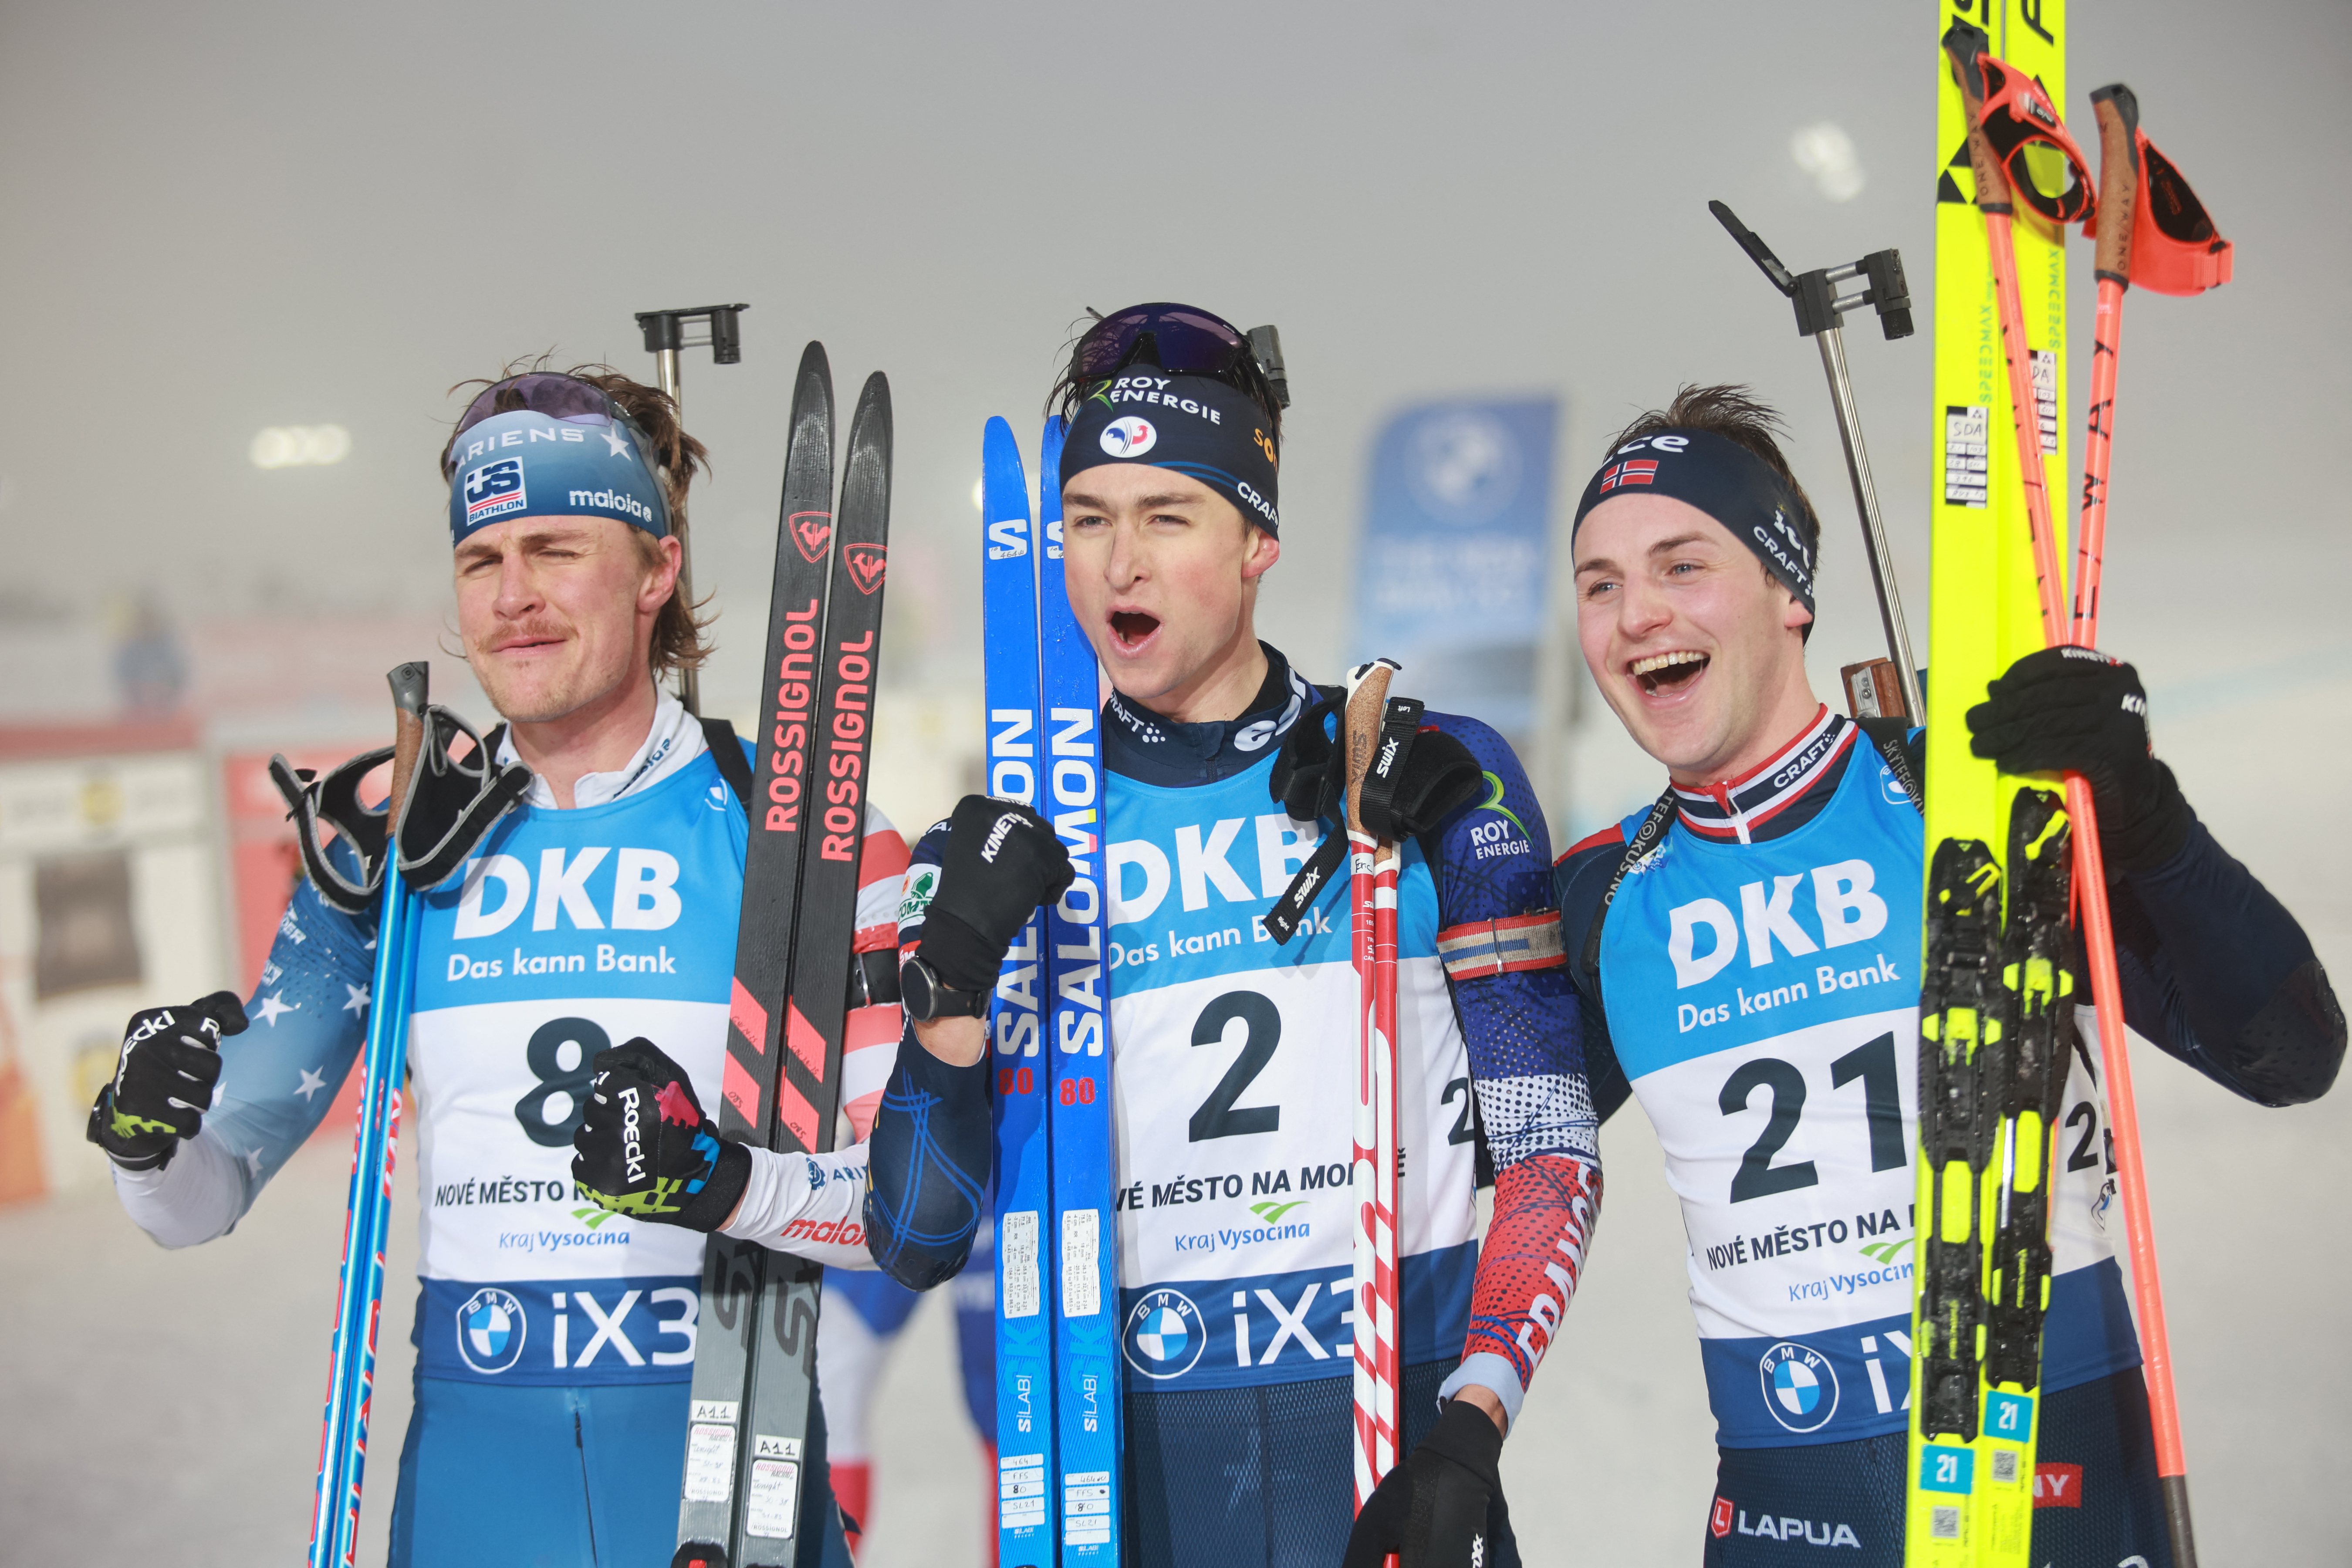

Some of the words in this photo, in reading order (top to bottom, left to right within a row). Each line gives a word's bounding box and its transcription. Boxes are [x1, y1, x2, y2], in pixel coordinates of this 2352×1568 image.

[1979, 305, 1993, 403] SPEEDMAX
[1114, 376, 1171, 390] ROY
[1110, 389, 1220, 425] ENERGIE
[456, 428, 585, 473] ARIENS
[469, 499, 524, 524] BIATHLON
[569, 489, 642, 518] maloja
[1753, 525, 1808, 584] CRAFT
[765, 599, 818, 831] ROSSIGNOL
[821, 630, 874, 862] ROSSIGNOL
[1773, 740, 1827, 789] CRAFT
[1470, 819, 1509, 846] ROY
[1476, 839, 1530, 860] ENERGIE
[1050, 707, 1103, 1058] SALOMON
[1106, 812, 1319, 926] DKB
[1355, 858, 1373, 873] Eric
[453, 846, 682, 940] DKB
[1109, 942, 1159, 972] Das
[1168, 927, 1241, 958] kann
[1251, 906, 1333, 943] Bnk
[1277, 916, 1290, 932] Right
[1668, 858, 1888, 990] DKB
[447, 954, 503, 982] Das
[513, 947, 585, 975] kann
[596, 944, 676, 973] Bank
[1677, 1003, 1730, 1034] Das
[1736, 982, 1809, 1016] kann
[1815, 953, 1901, 995] Bank
[517, 1017, 612, 1147] 8
[998, 1067, 1034, 1095] 80
[1189, 990, 1282, 1143] 2
[1059, 1077, 1096, 1105] 80
[1441, 1077, 1475, 1146] 2
[1718, 1031, 1907, 1204] 21
[2065, 1101, 2099, 1173] 2
[435, 1177, 475, 1206] NOVÉ
[479, 1175, 564, 1203] MĚSTO
[1152, 1173, 1243, 1208] MĚSTO
[1251, 1168, 1292, 1196] NA
[499, 1232, 534, 1252] Kraj
[539, 1231, 630, 1251] Vysocina
[1175, 1232, 1215, 1252] Kraj
[1218, 1222, 1310, 1250] Vysocina
[1706, 1235, 1745, 1271] NOVÉ
[1751, 1219, 1848, 1260] MĚSTO
[1856, 1207, 1901, 1239] NA
[1789, 1281, 1829, 1302] Kraj
[1829, 1261, 1915, 1295] Vysocin
[1137, 1293, 1192, 1320] BMW
[468, 1291, 516, 1315] BMW
[552, 1286, 700, 1369] iX3
[1763, 1346, 1821, 1374] BMW
[694, 1427, 733, 1436] ROSSIGNOL
[1998, 1401, 2019, 1430] 21
[760, 1440, 796, 1456] A11
[756, 1462, 795, 1473] ROSSIGNOL
[1936, 1453, 1958, 1484] 21
[753, 1523, 788, 1533] ROSSIGNOL
[1738, 1510, 1862, 1548] LAPUA
